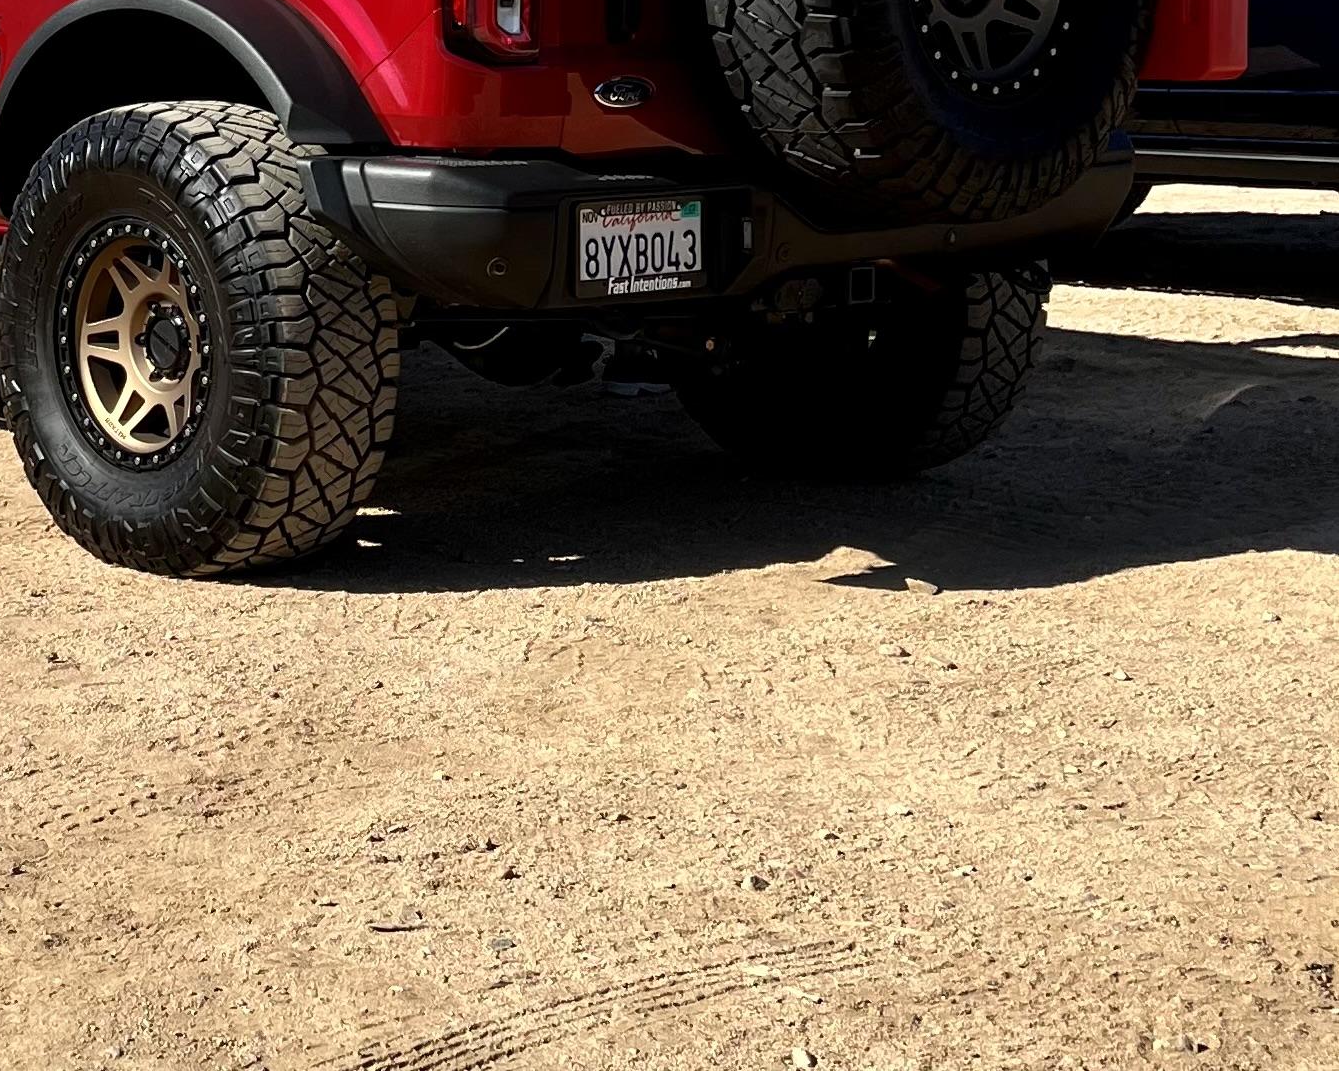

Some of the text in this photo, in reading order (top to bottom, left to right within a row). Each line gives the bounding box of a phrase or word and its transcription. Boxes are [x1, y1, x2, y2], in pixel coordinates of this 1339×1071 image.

[582, 211, 598, 224] NOV
[606, 202, 634, 217] FUELED
[636, 201, 646, 213] BY
[647, 199, 677, 212] PASSION
[585, 229, 697, 279] 8YXB043
[607, 275, 629, 296] Fast
